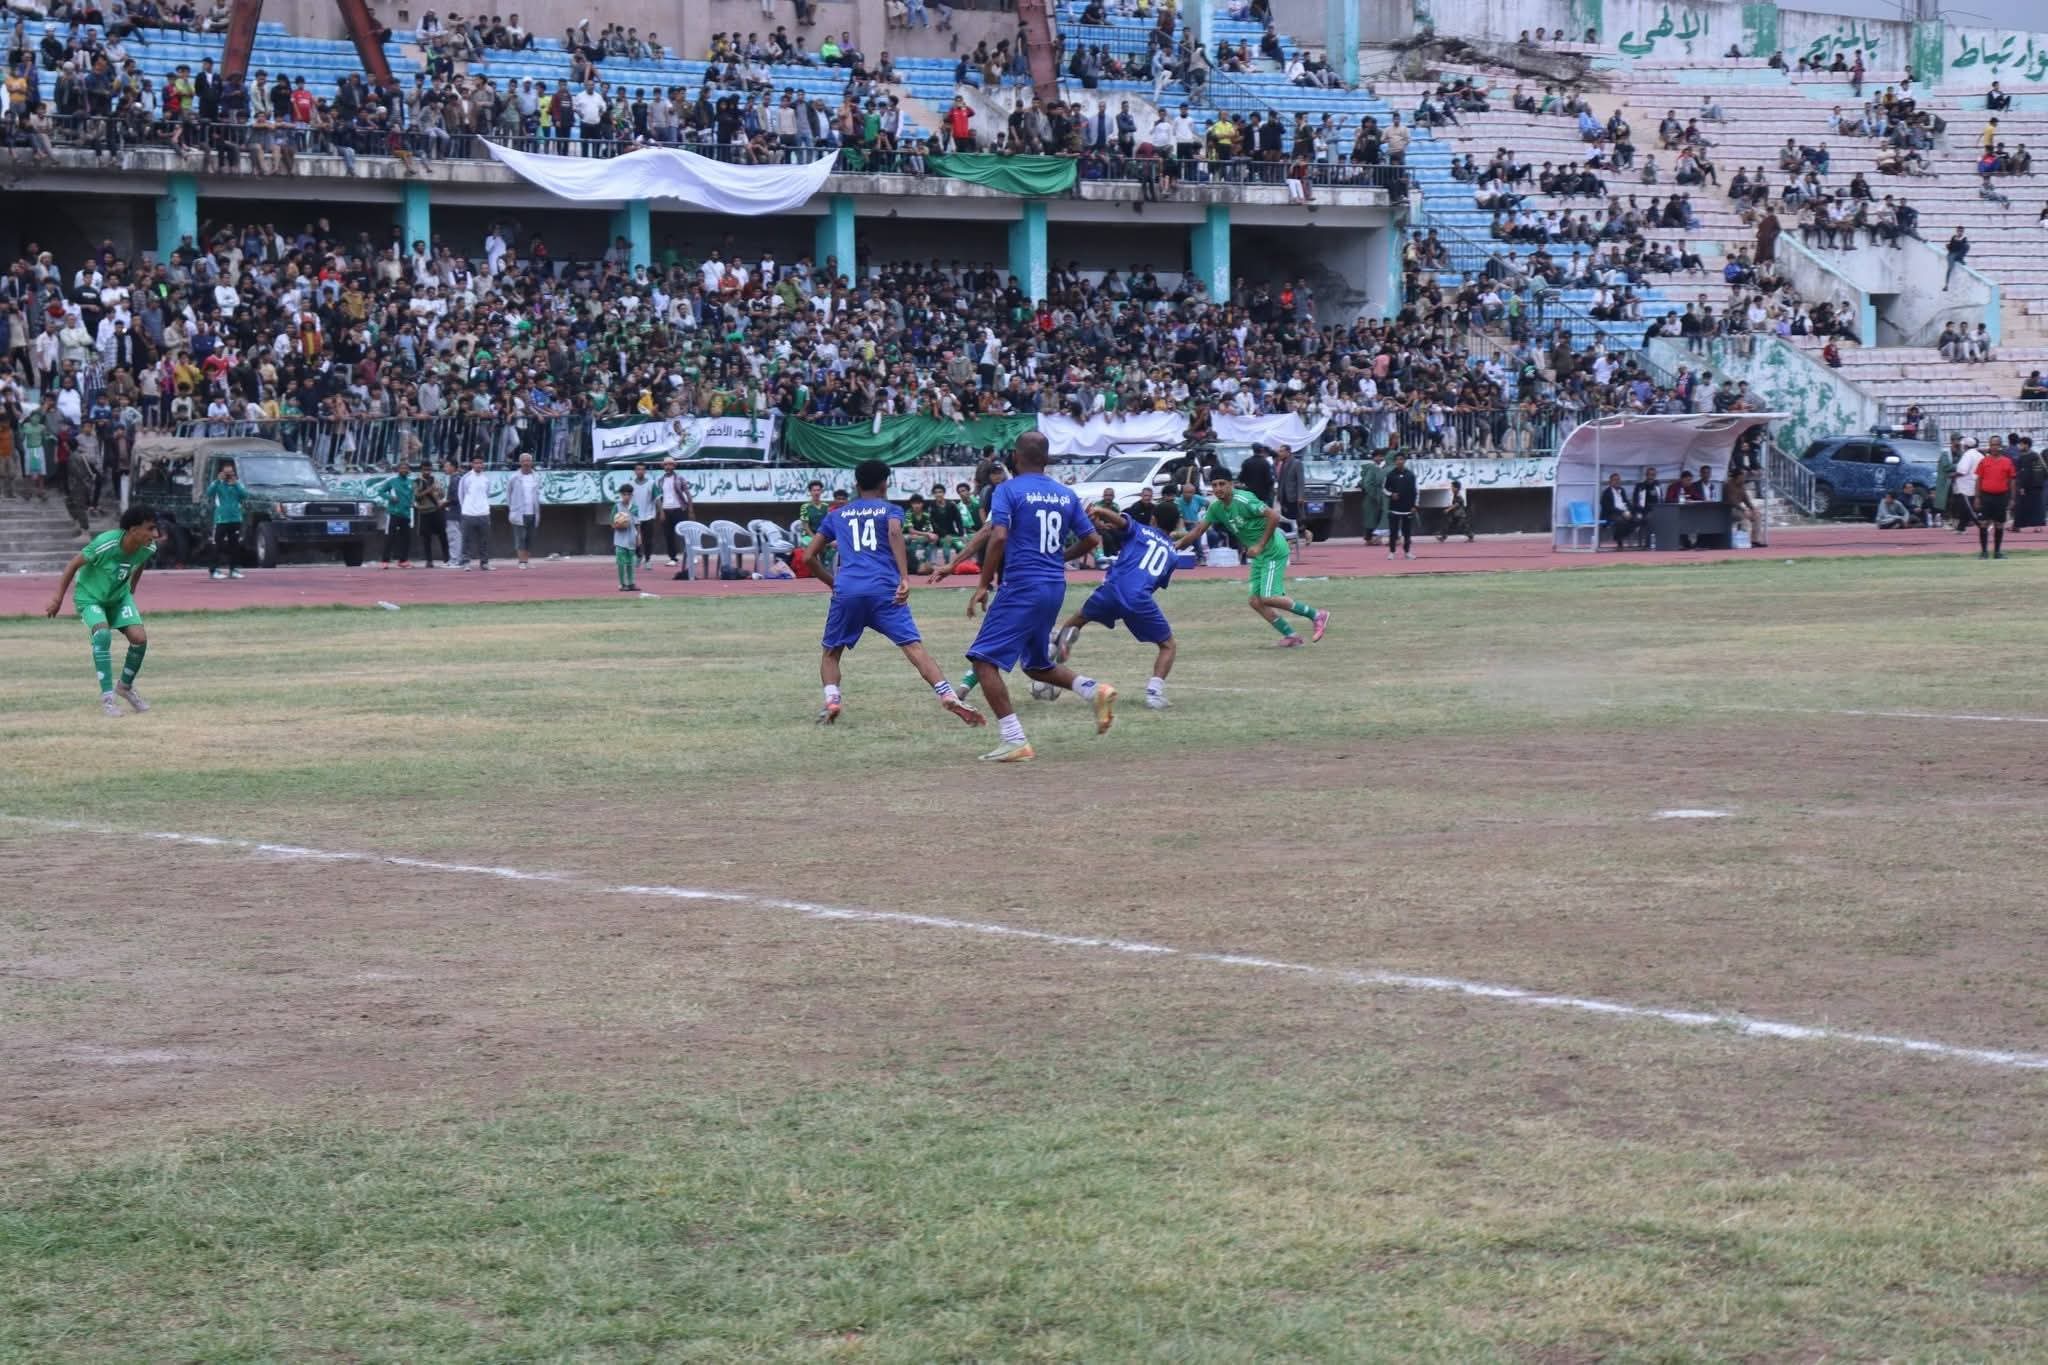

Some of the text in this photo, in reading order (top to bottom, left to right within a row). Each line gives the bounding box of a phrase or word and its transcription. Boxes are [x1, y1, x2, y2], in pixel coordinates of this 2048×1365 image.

[848, 518, 877, 551] 14
[1036, 509, 1062, 553] 18
[1139, 539, 1168, 576] 10
[121, 605, 133, 618] 21
